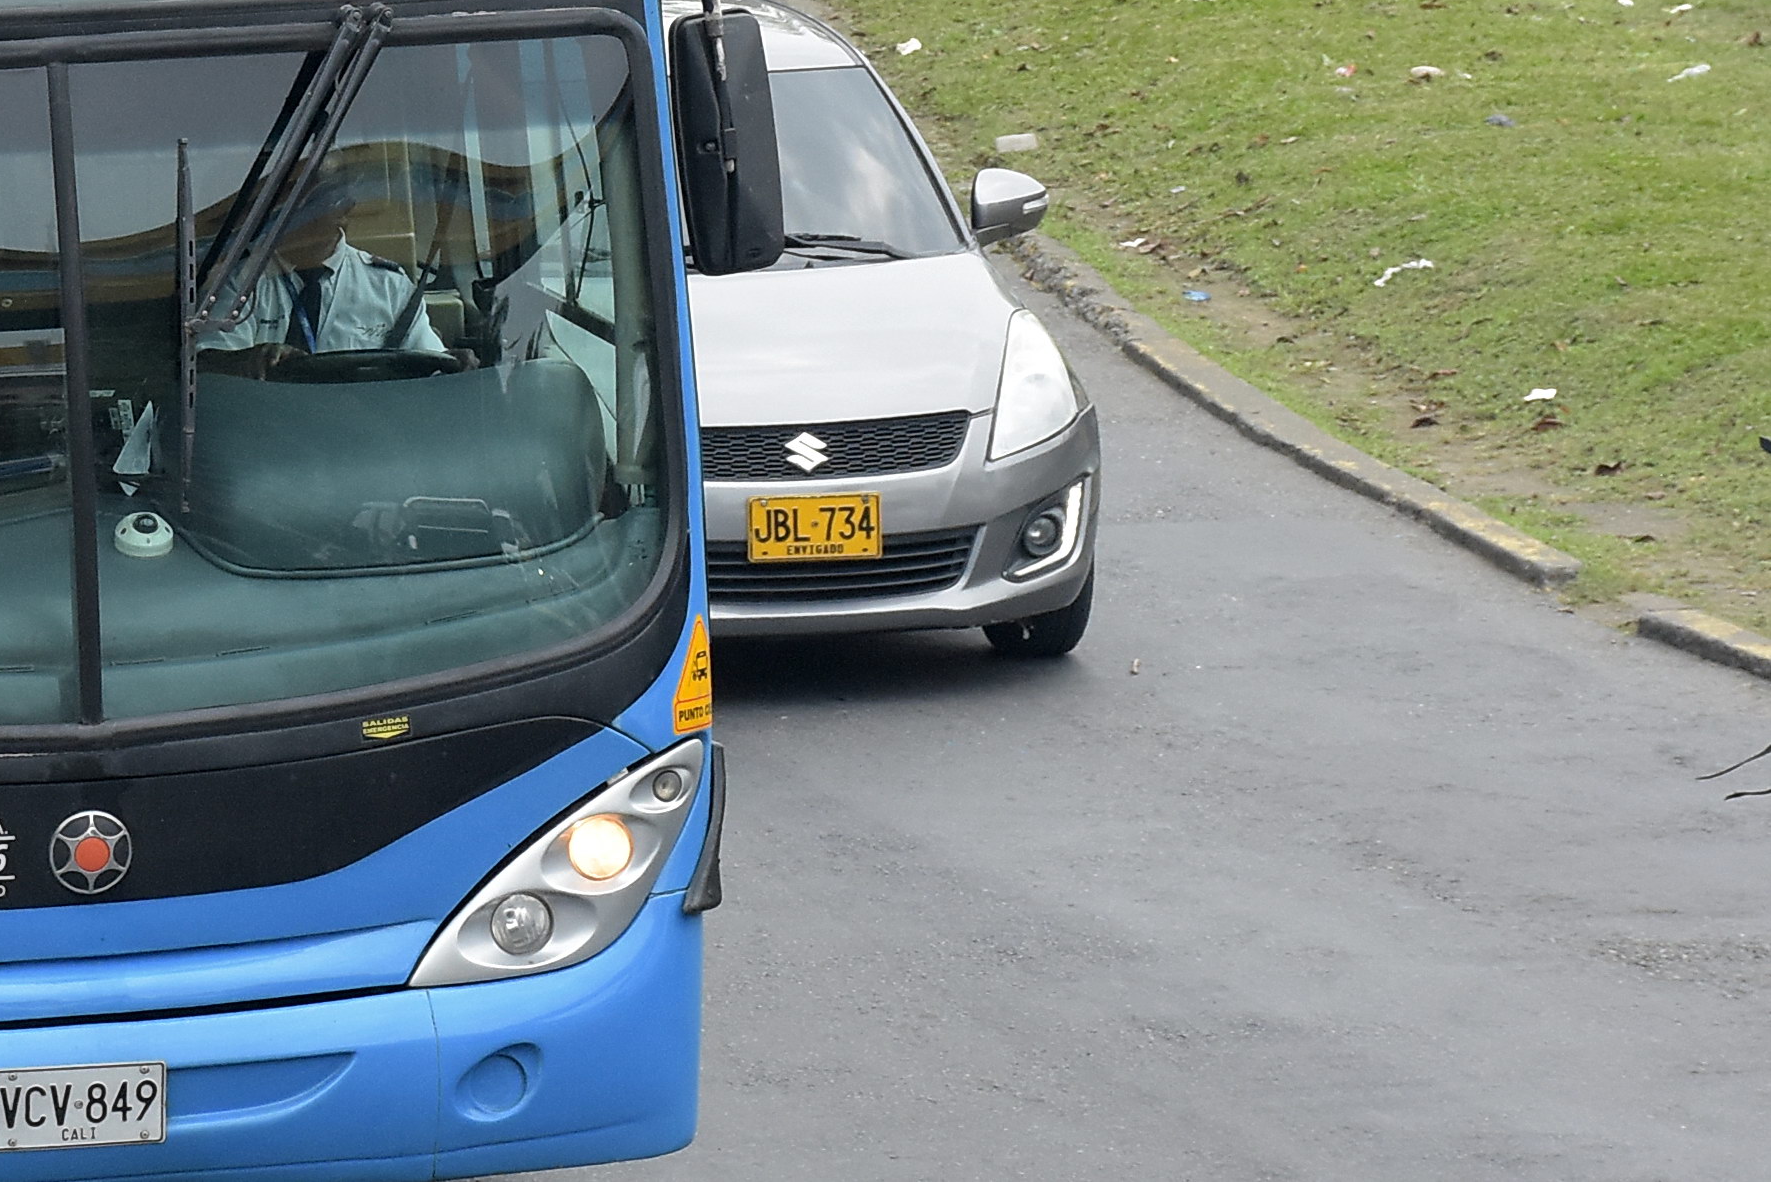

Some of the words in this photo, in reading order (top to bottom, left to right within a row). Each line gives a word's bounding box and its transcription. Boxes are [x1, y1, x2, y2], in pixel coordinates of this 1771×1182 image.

[786, 544, 844, 556] ENVIGADO
[679, 705, 703, 722] PUNTO
[362, 715, 409, 727] SALIDAS
[362, 723, 409, 735] EMERGENCIA
[61, 1128, 97, 1141] CALI
